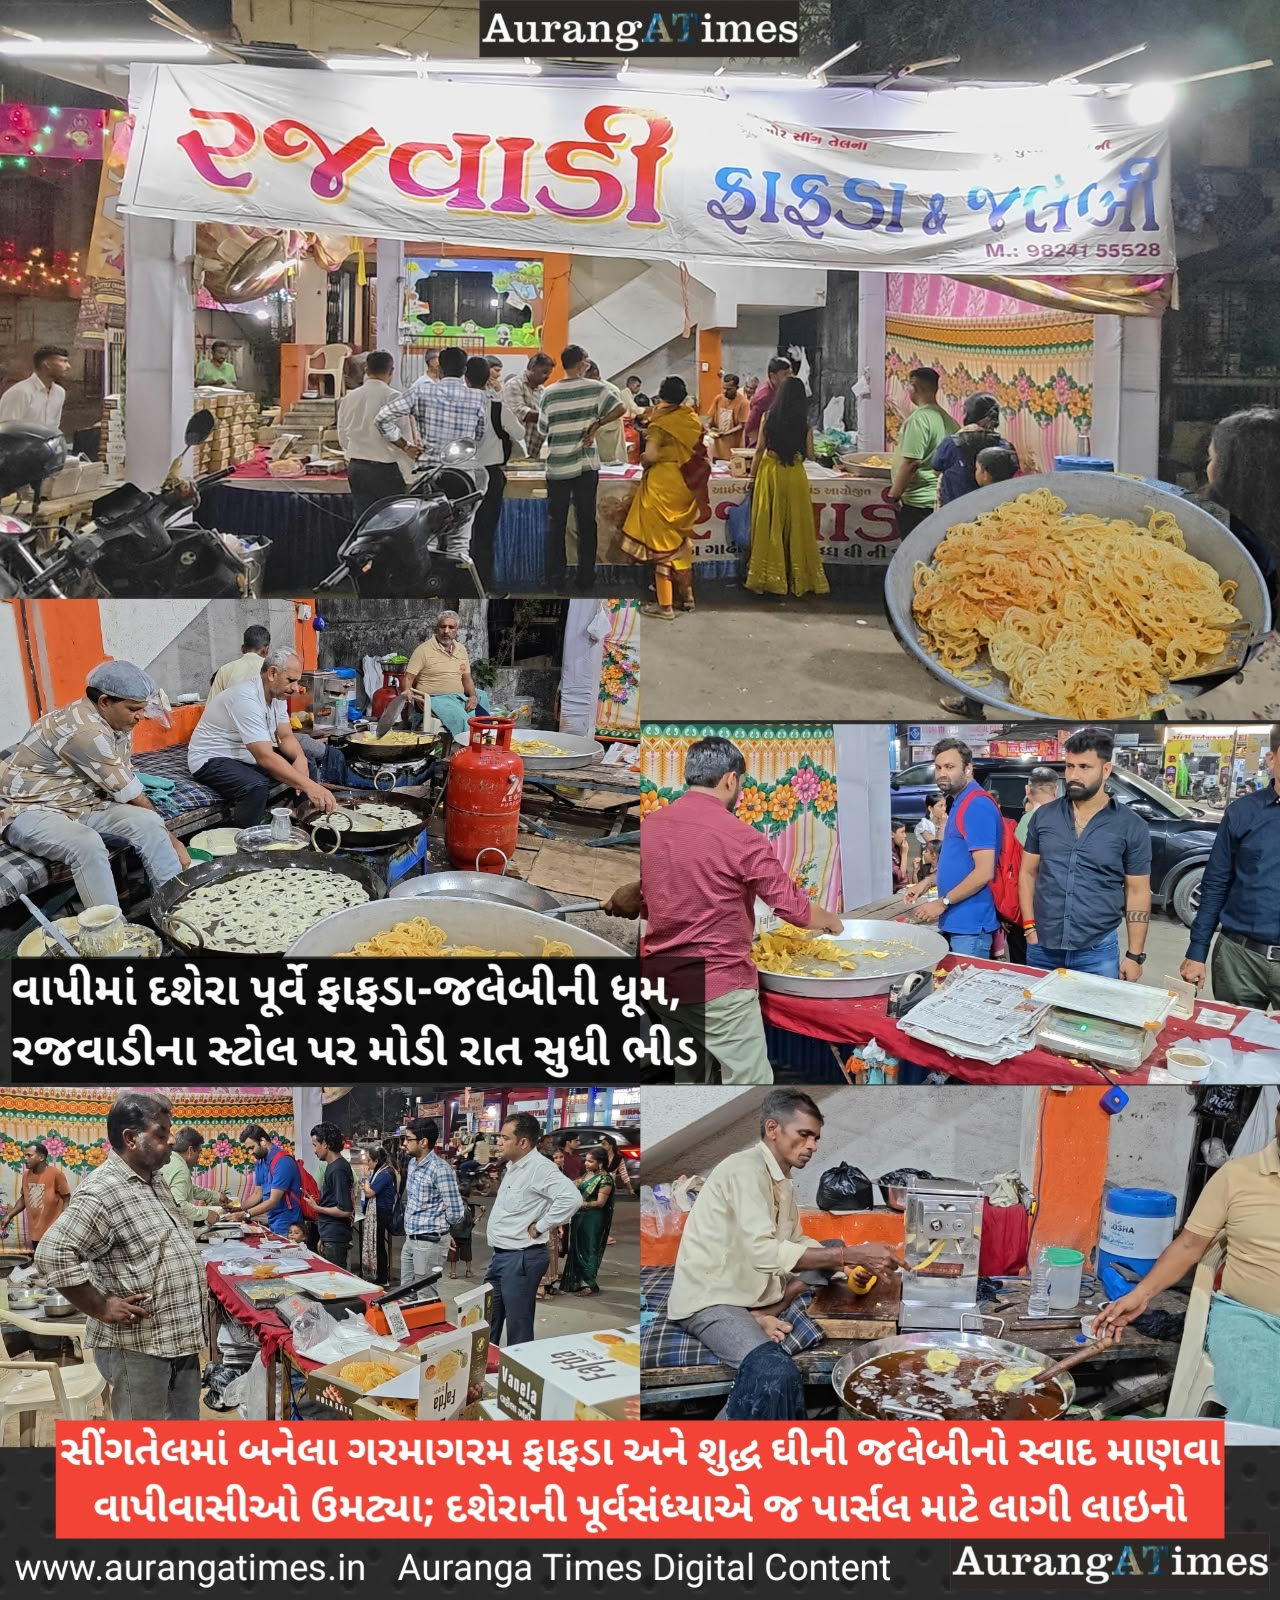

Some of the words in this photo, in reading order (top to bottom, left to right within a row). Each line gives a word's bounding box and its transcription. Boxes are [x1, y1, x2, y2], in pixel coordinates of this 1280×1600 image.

[177, 104, 676, 228] રજવાડી
[707, 166, 908, 239] ફાફડા
[921, 193, 947, 236] &
[1027, 243, 1089, 258] 98241
[1096, 242, 1161, 257] 55528
[550, 1350, 617, 1382] Fafda
[433, 1382, 456, 1412] Fafda
[502, 1365, 538, 1406] Vanela
